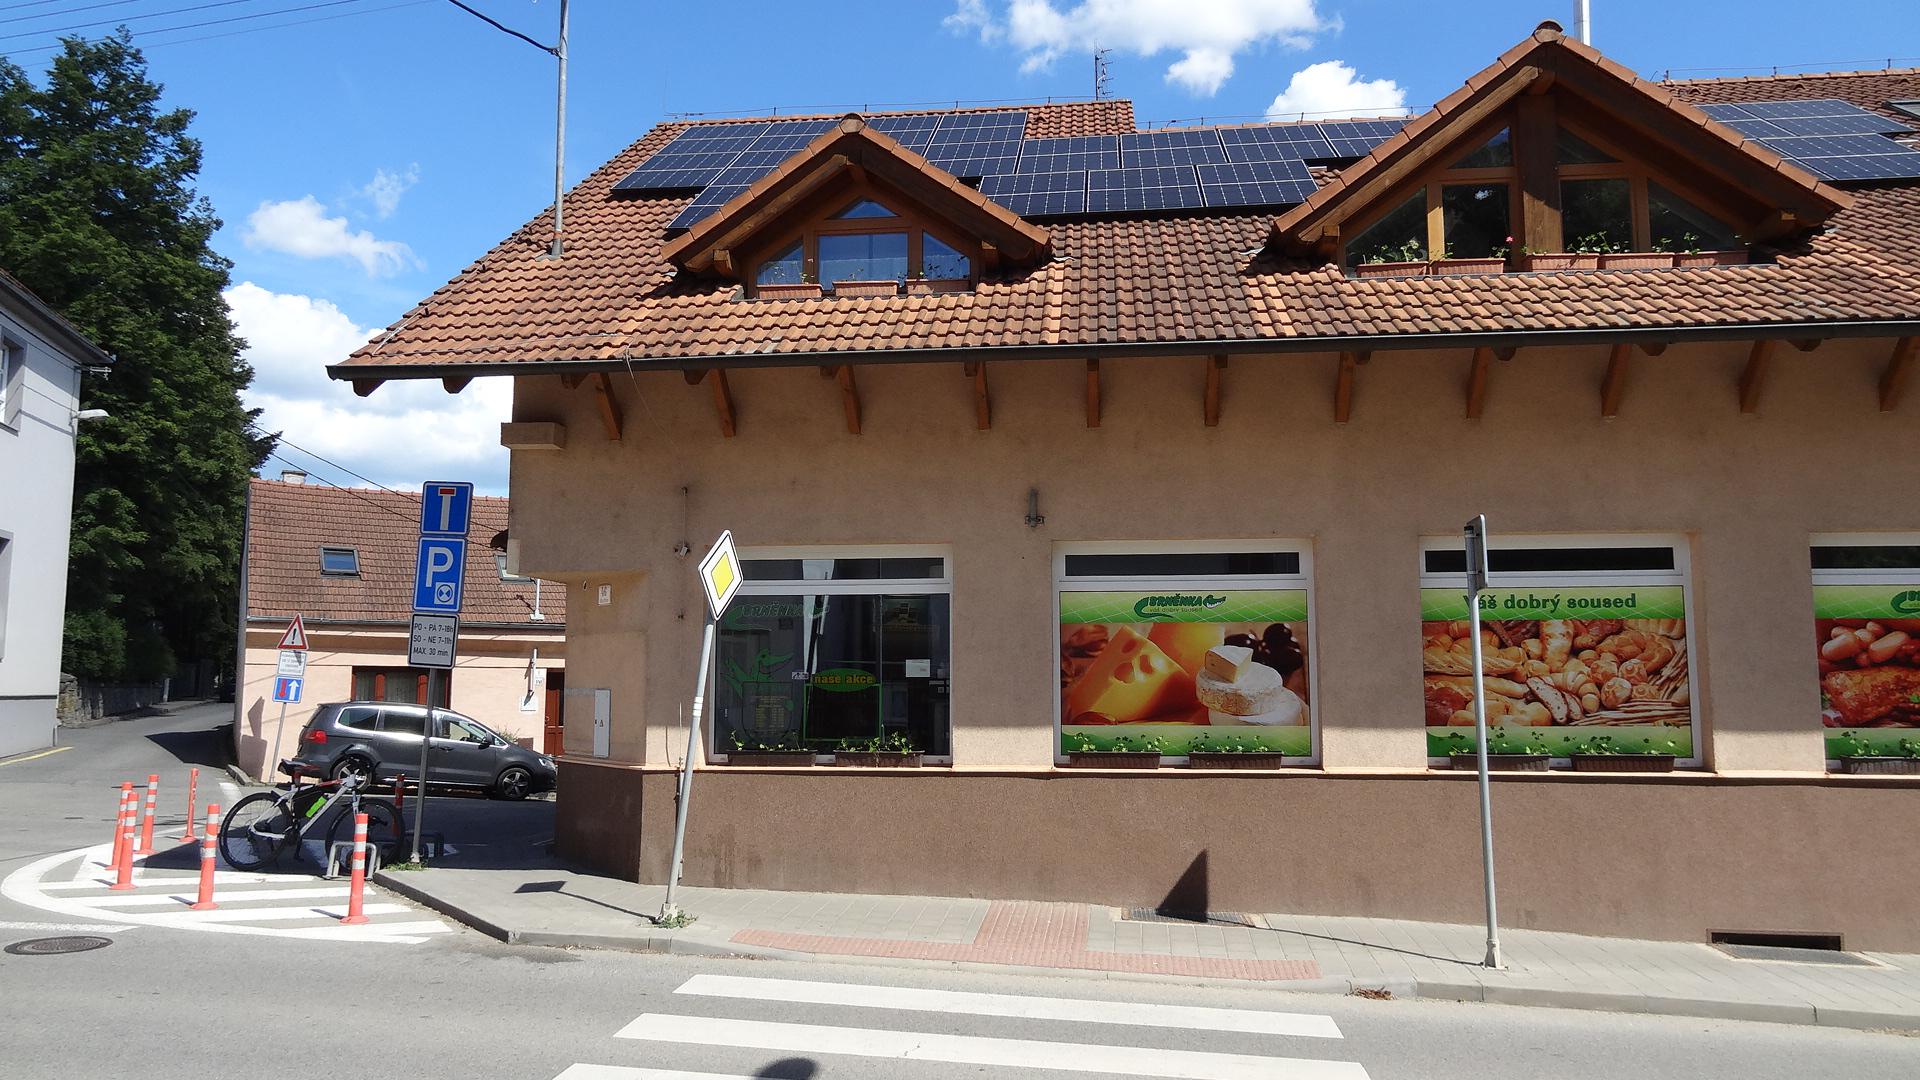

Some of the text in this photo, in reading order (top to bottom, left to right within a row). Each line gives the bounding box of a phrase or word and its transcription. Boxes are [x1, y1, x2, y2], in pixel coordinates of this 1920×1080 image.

[426, 547, 453, 587] P
[1149, 593, 1203, 606] BRNĚNKA
[1504, 594, 1561, 613] dobrý
[1567, 593, 1637, 609] soused
[414, 622, 423, 631] PO
[413, 634, 422, 643] SO
[427, 635, 437, 644] NE
[429, 647, 437, 656] 30
[846, 674, 873, 685] akce
